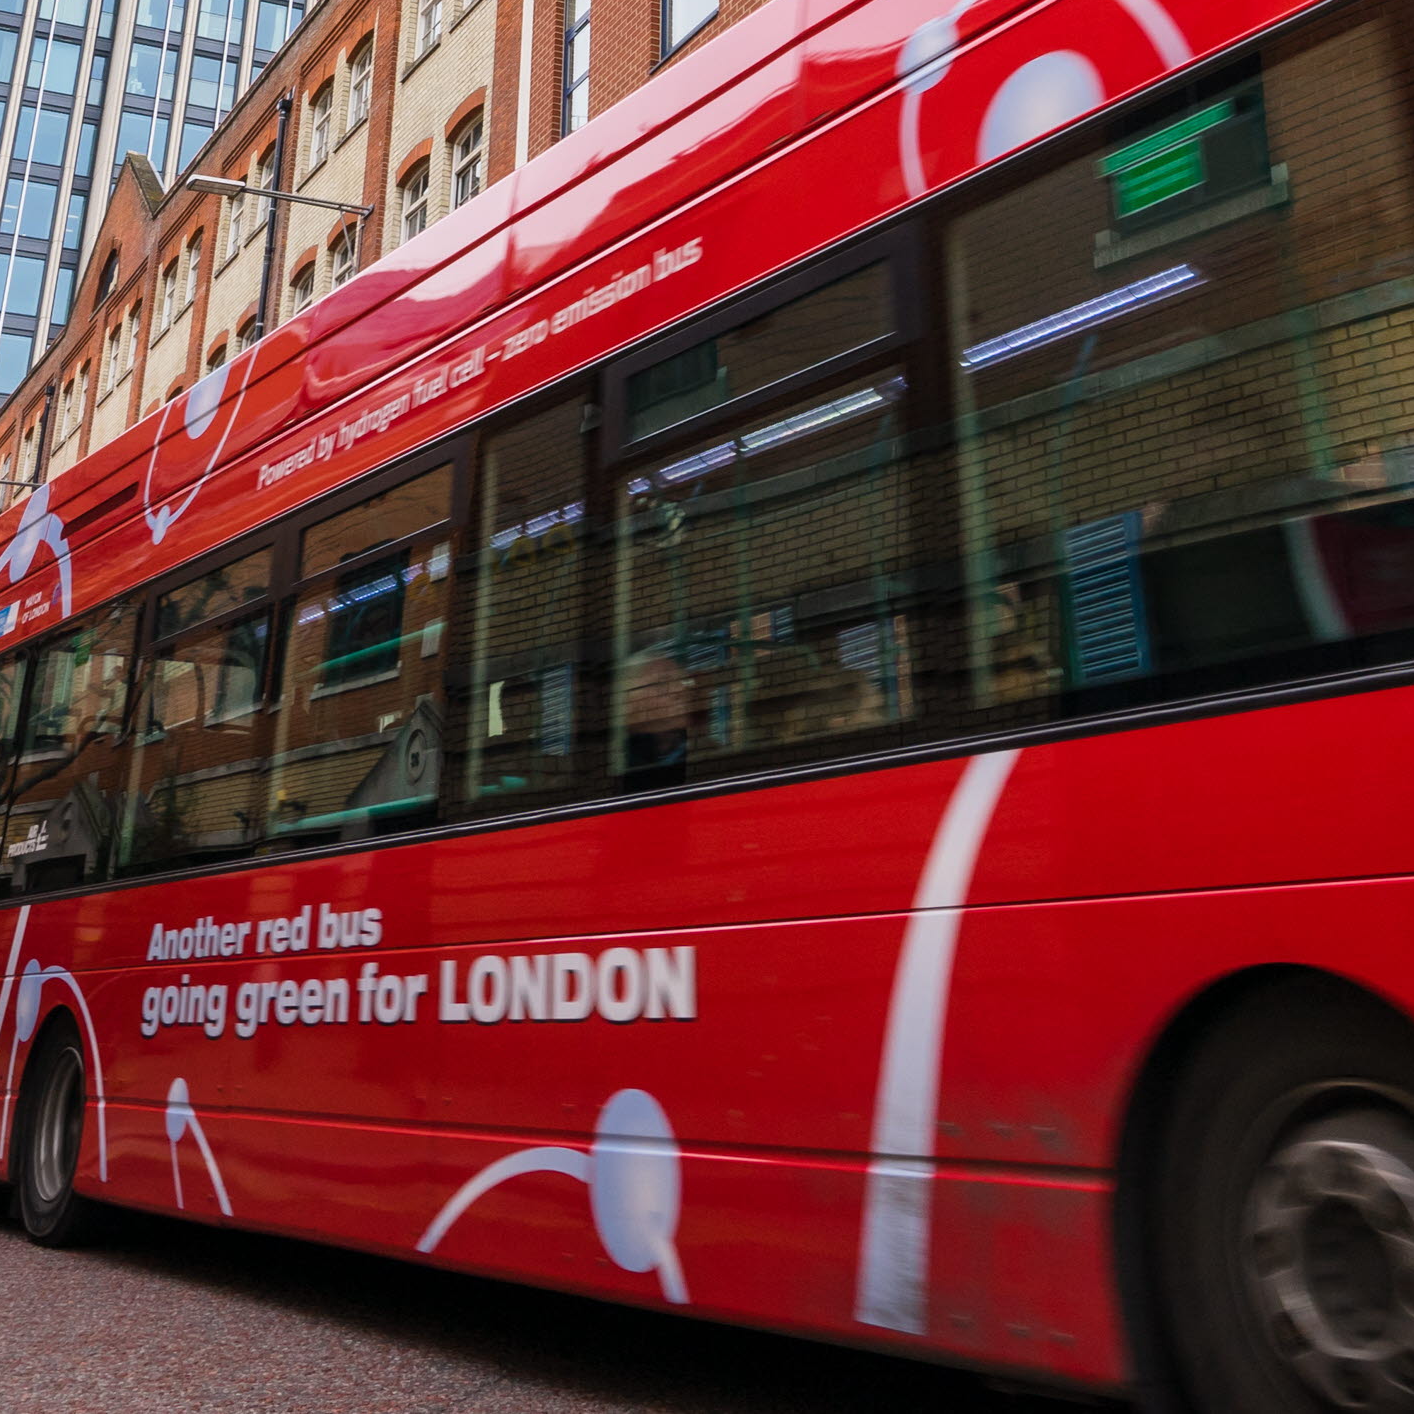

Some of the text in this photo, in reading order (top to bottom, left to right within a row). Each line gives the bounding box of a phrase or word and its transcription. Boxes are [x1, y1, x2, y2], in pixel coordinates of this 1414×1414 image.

[257, 437, 317, 491] Powered
[315, 432, 337, 462] by
[337, 392, 411, 450] hydrogen
[411, 365, 449, 410] fuel
[449, 345, 485, 389] cell
[501, 318, 549, 362] zero
[551, 270, 652, 335] emission
[652, 236, 703, 283] bus
[146, 903, 383, 961] Another red bus
[141, 945, 698, 1039] going green for LONDON
